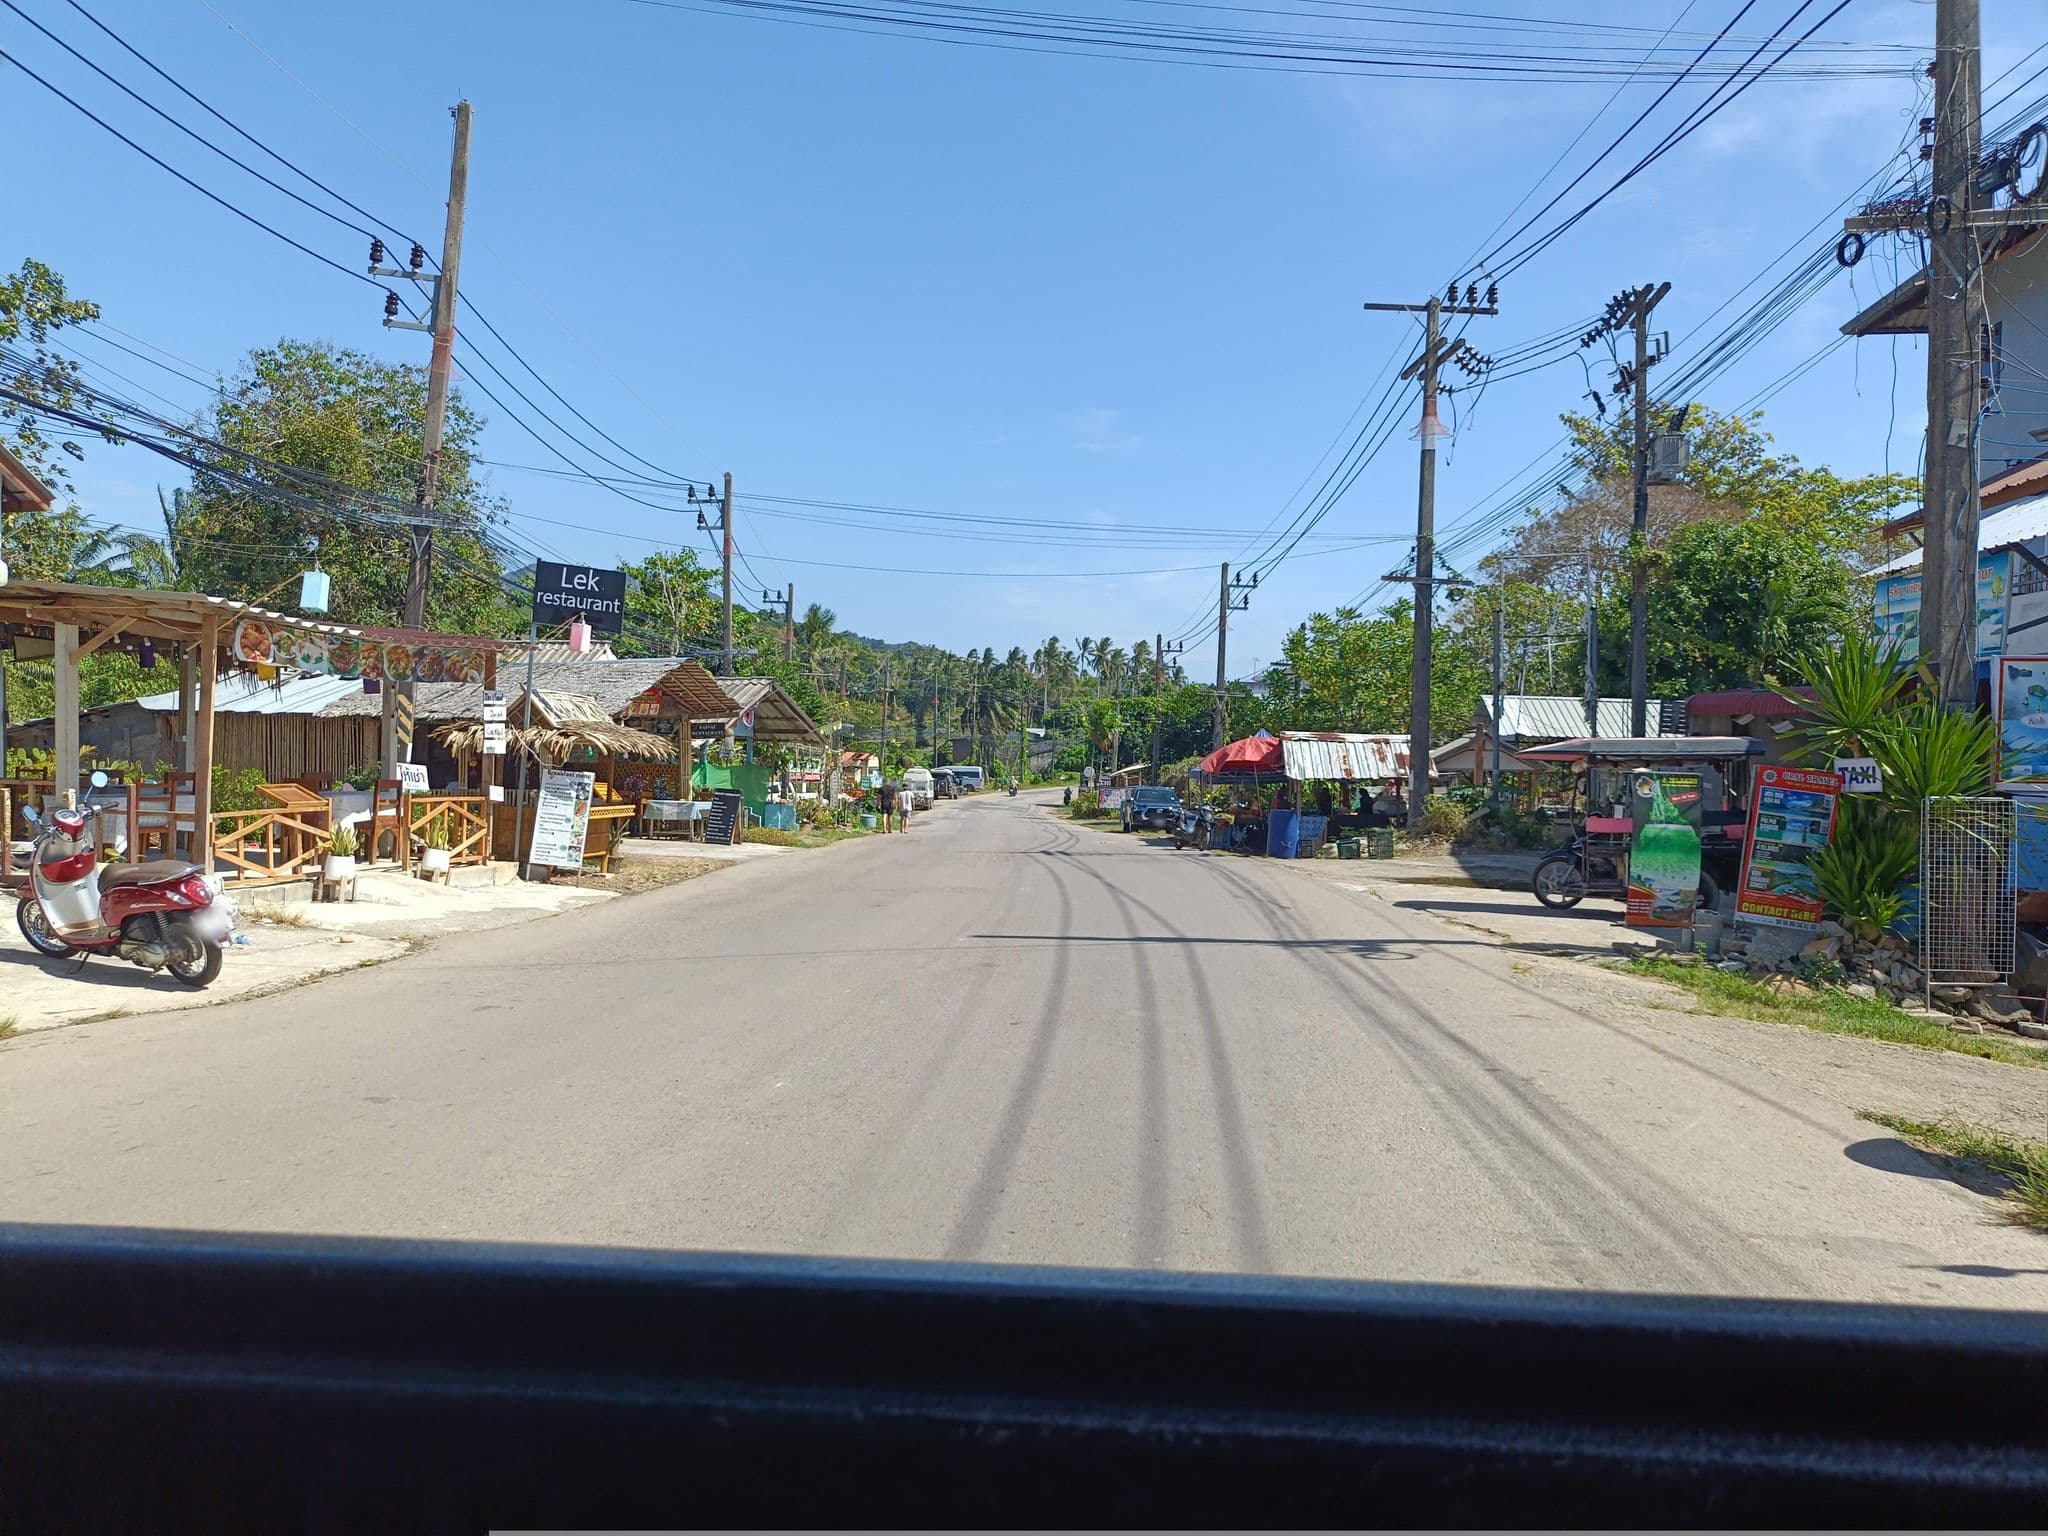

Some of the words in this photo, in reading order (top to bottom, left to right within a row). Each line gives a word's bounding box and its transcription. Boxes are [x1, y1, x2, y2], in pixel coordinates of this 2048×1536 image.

[561, 567, 600, 592] Lek
[536, 591, 621, 614] restaurant
[1807, 774, 1840, 787] TRAVEL
[1838, 765, 1876, 784] TAXI
[1742, 902, 1790, 918] CONTACT
[1791, 908, 1817, 921] HERE
